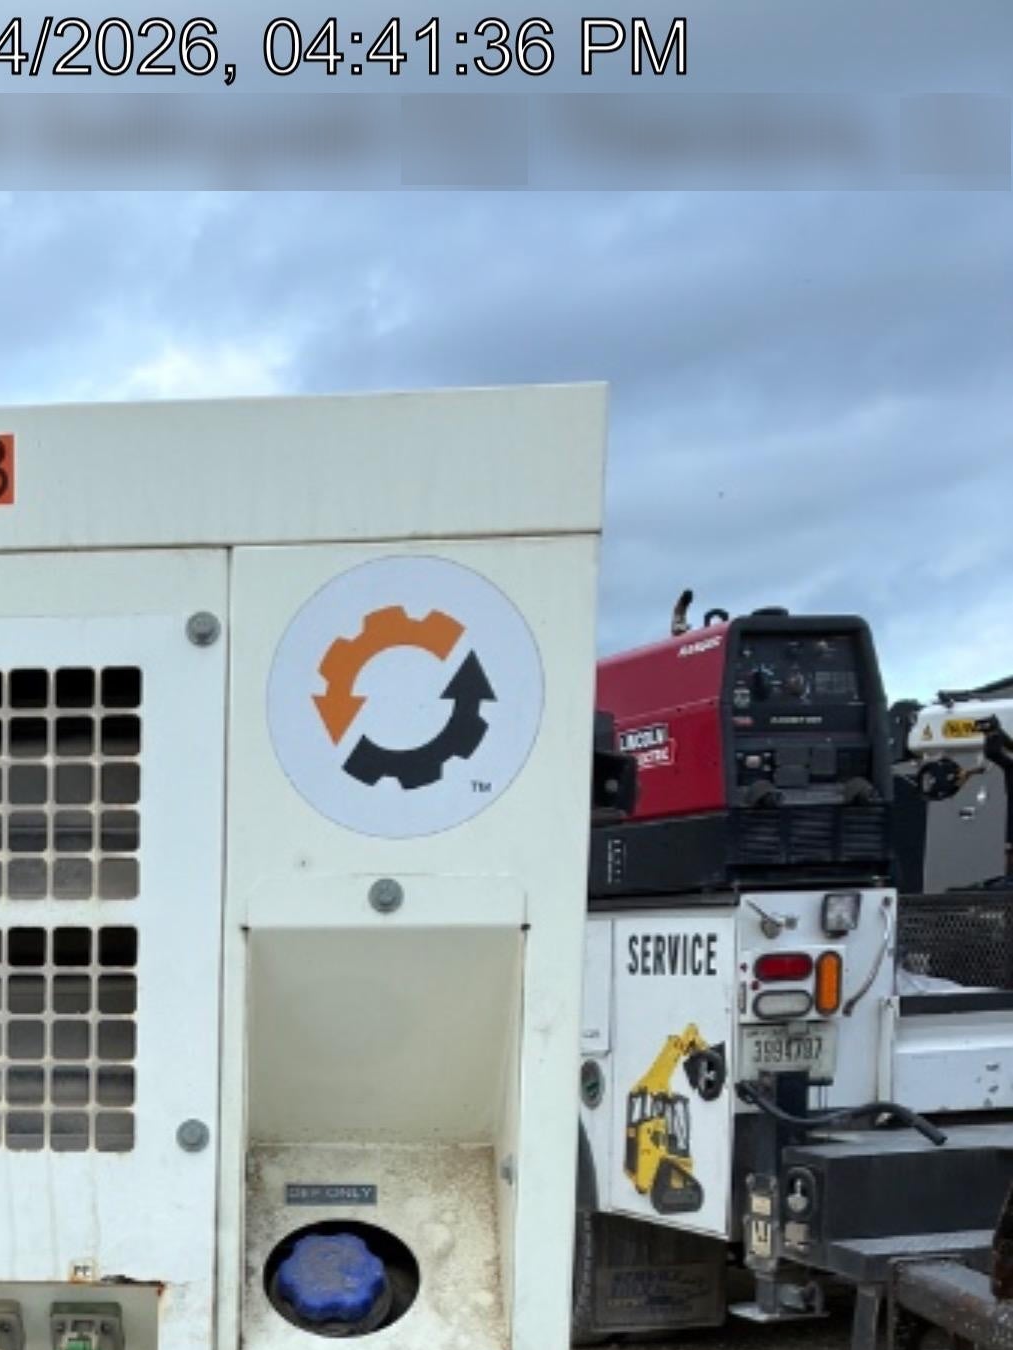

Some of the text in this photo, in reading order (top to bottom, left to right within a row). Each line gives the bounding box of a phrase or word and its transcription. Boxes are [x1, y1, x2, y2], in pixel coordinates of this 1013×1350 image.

[470, 779, 493, 793] TM
[627, 932, 718, 977] SERVICE
[326, 1186, 372, 1199] ONLY
